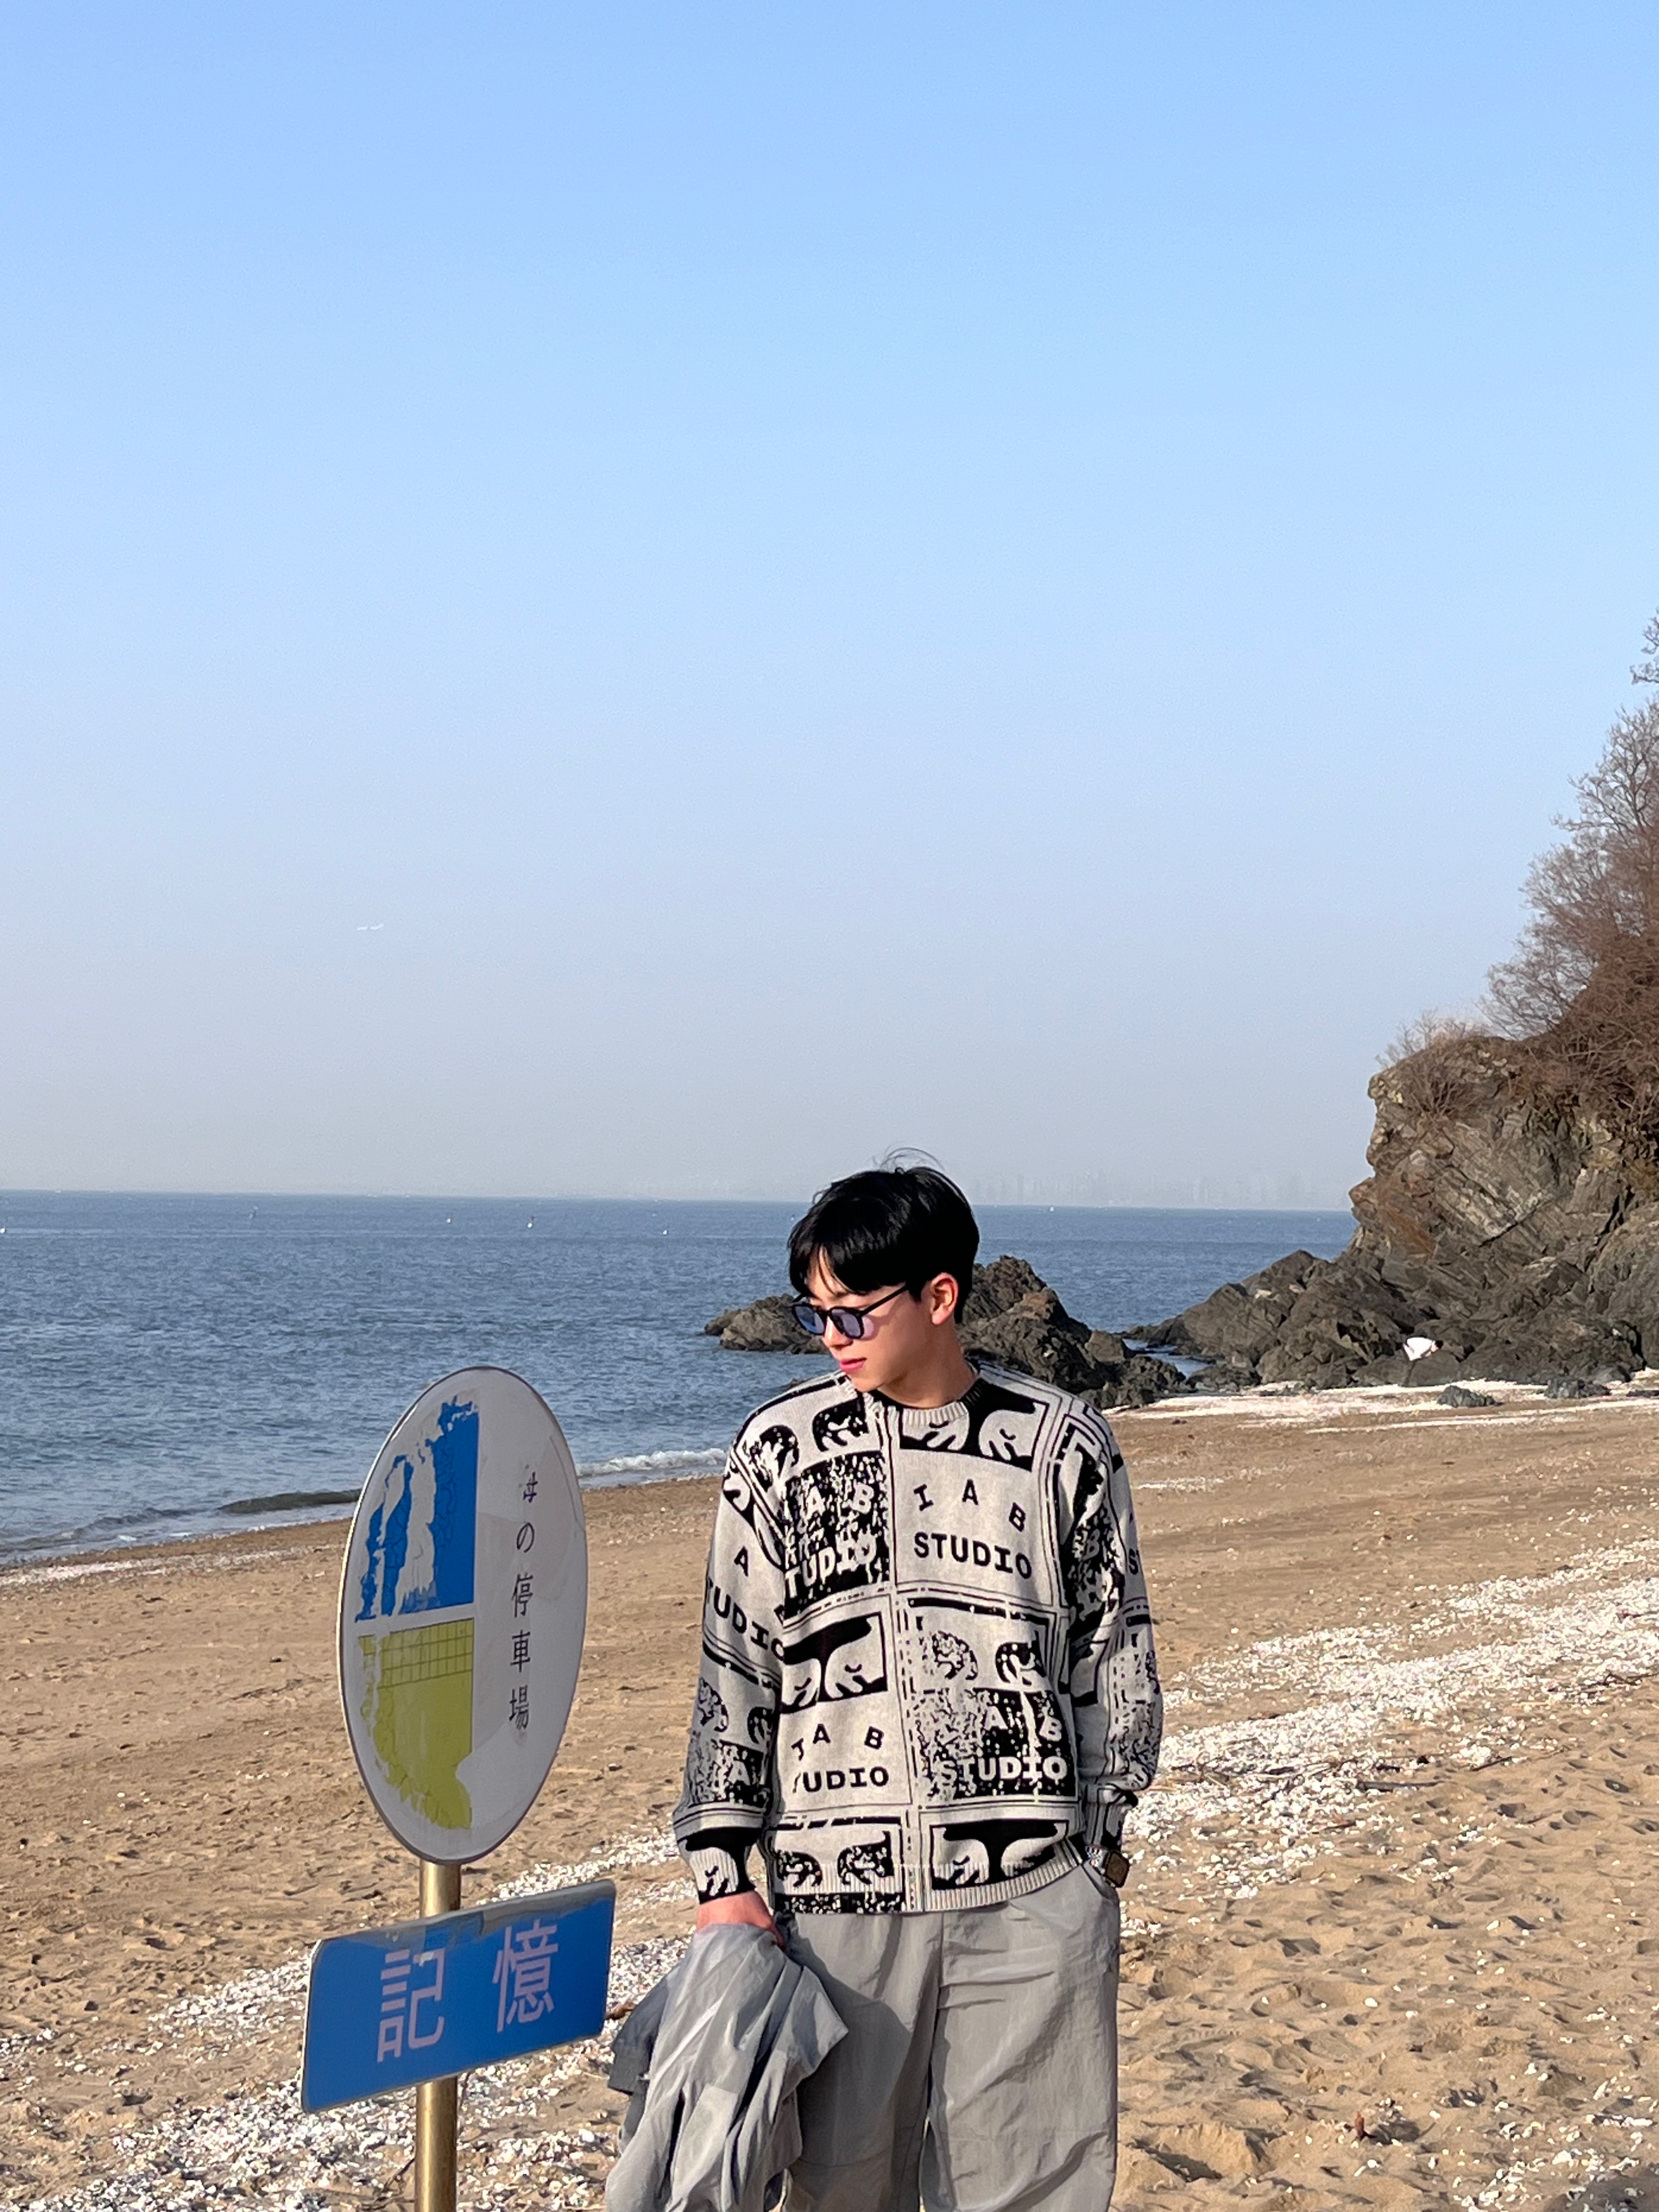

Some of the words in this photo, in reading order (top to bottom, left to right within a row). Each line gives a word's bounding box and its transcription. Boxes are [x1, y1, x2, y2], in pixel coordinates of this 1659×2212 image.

[785, 1532, 877, 1599] TUDIO
[913, 1531, 1033, 1580] STUDIO
[939, 1755, 1068, 1785] STUDIO
[376, 1919, 560, 2063] 記憶
